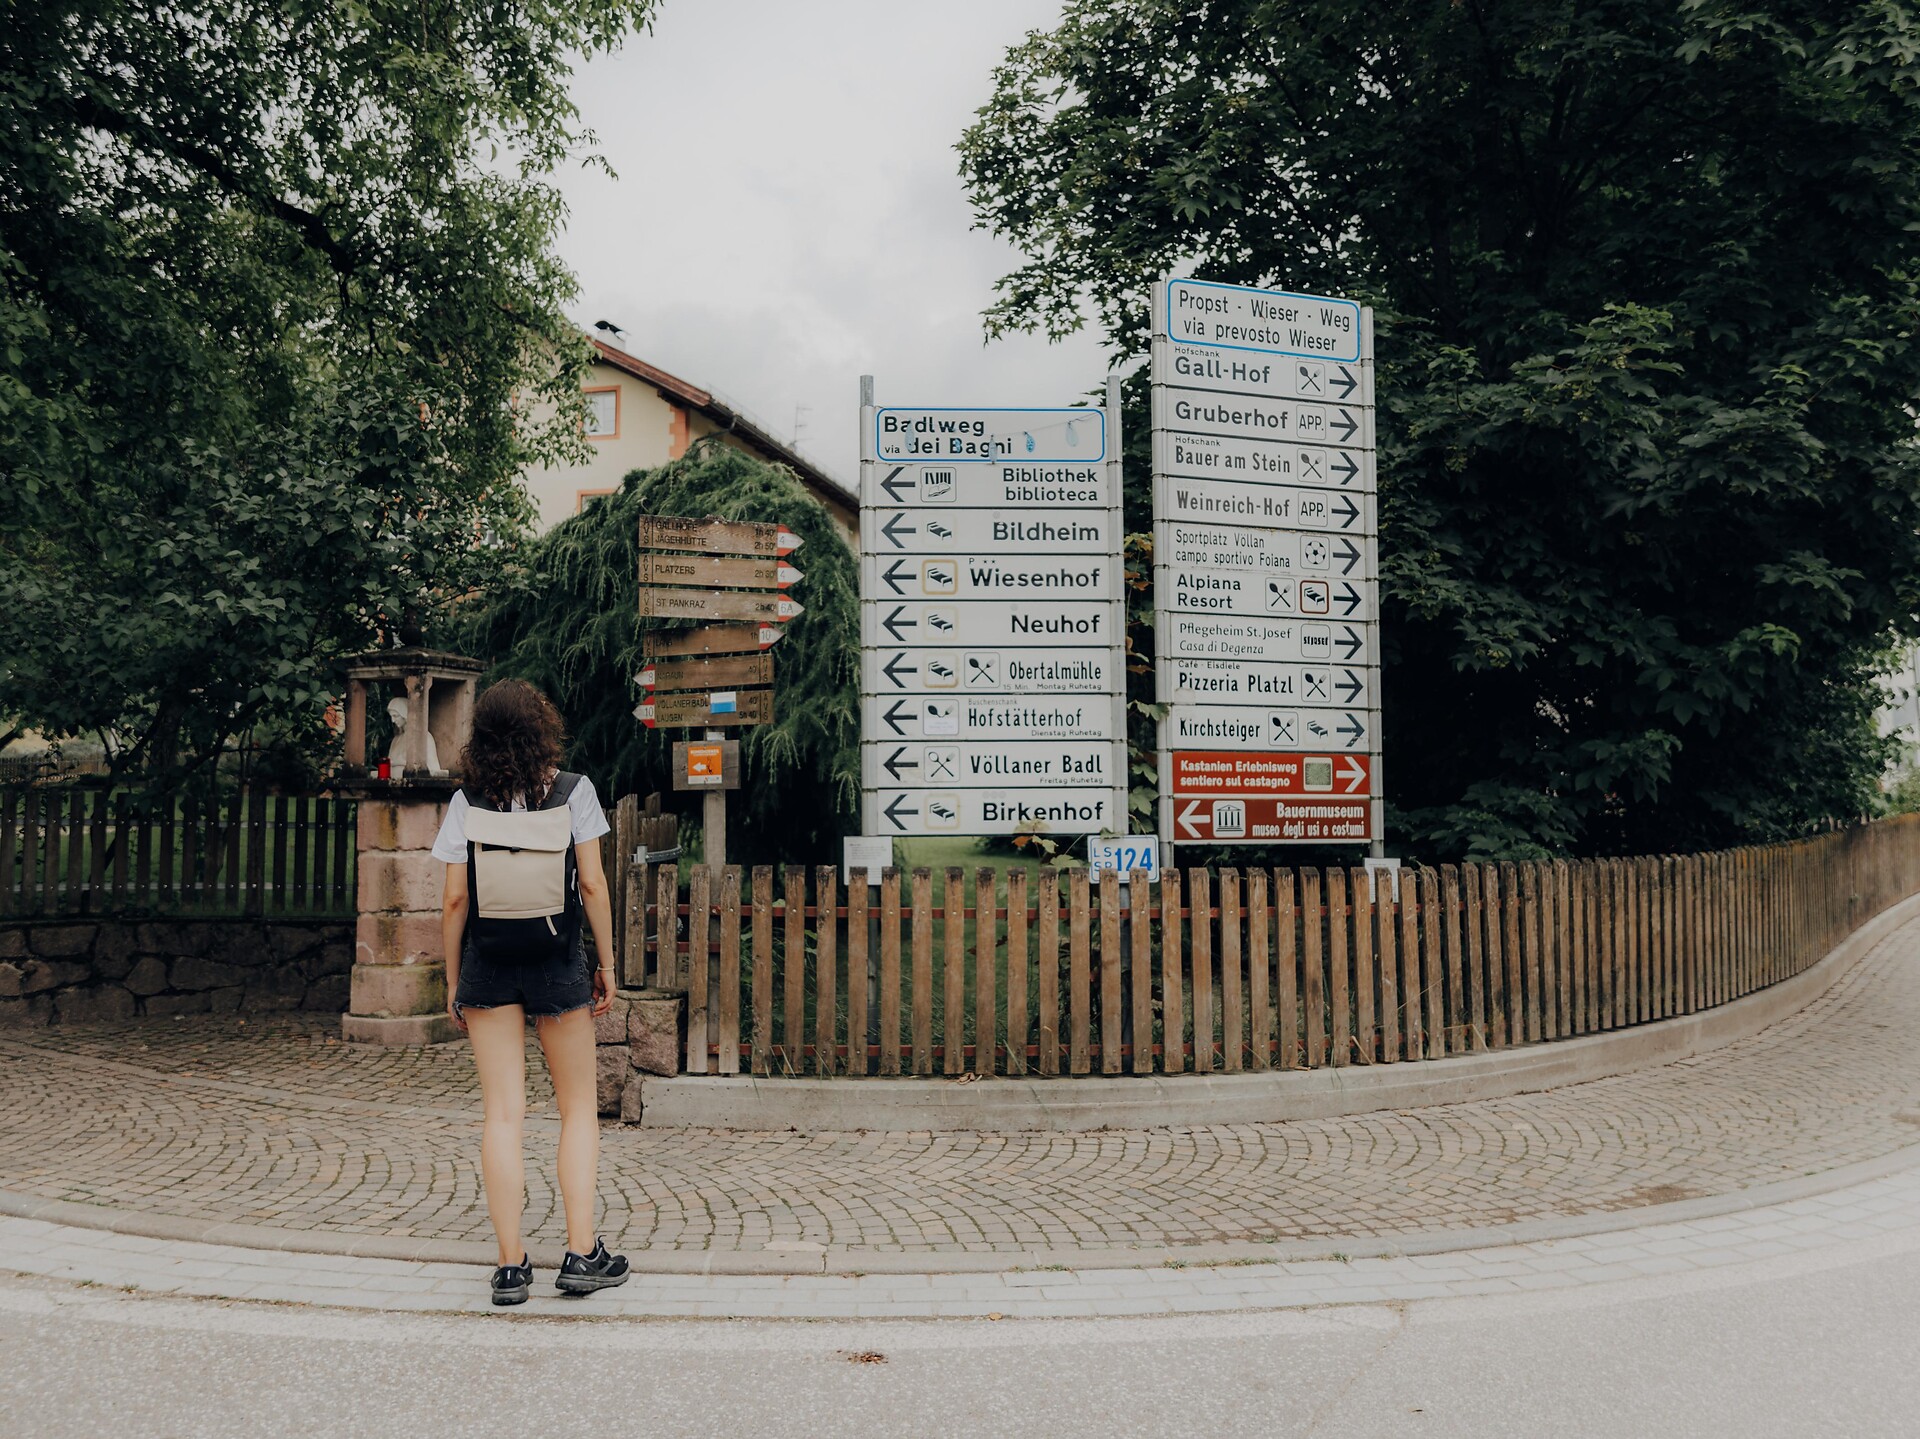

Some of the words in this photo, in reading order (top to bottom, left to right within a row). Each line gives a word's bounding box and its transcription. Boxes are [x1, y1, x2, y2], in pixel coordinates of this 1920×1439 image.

[1179, 289, 1229, 314] Propst
[1251, 299, 1299, 322] Wieser
[1320, 308, 1350, 332] Weg
[1184, 317, 1205, 336] via
[1216, 321, 1280, 344] prevosto
[1289, 329, 1336, 351] Wieser
[1174, 346, 1220, 358] Hofschank
[1175, 356, 1270, 384] Gall-Hof
[1175, 401, 1288, 429] Gruberhof
[1299, 414, 1324, 431] APP.
[884, 416, 984, 437] Badlweg
[885, 445, 900, 453] via
[1175, 436, 1221, 447] Hofschank
[1175, 446, 1219, 467] Bauer
[1225, 454, 1246, 469] am
[1253, 452, 1290, 473] Stein
[1002, 468, 1098, 482] Bibliothek
[1005, 487, 1098, 501] biblioteca
[1177, 490, 1290, 517] Weinreich-Hof
[1300, 502, 1325, 518] APP.
[993, 522, 1099, 541] Bildheim
[1176, 529, 1227, 546] Sportplatz
[1234, 533, 1264, 549] Völlan
[1176, 550, 1207, 565] campo
[1214, 551, 1253, 567] sportivo
[1259, 553, 1290, 568] Foiana
[655, 565, 695, 575] PLATZERS
[970, 568, 1100, 587] Wiesenhof
[1177, 573, 1241, 591] Alpiana
[669, 599, 705, 609] PANKRAZ
[780, 603, 793, 613] 6A
[1178, 592, 1233, 609] Resort
[1011, 614, 1100, 633] Neuhof
[1180, 622, 1243, 637] Pflegeheim
[1263, 627, 1292, 640] Josef
[761, 630, 771, 640] 10
[1180, 640, 1204, 652] Casa
[1207, 641, 1217, 652] di
[1221, 642, 1263, 656] Degenza
[1009, 661, 1101, 680] Obertalmühle
[1207, 661, 1240, 670] Eisdiele
[1037, 683, 1066, 691] Montag
[1069, 683, 1102, 691] Ruhetag
[1179, 672, 1238, 692] Pizzeria
[1248, 674, 1293, 694] Platzl
[644, 707, 654, 717] 10
[968, 708, 1082, 727] Hofstätterhof
[1031, 729, 1066, 737] Dienstag
[1069, 729, 1102, 737] Ruhetag
[1180, 717, 1260, 742] Kirchsteiger
[970, 755, 1051, 774] Völlaner
[1062, 754, 1103, 774] Badl
[1180, 760, 1232, 772] Kastanien
[1235, 760, 1297, 775] Erlebnisweg
[1071, 776, 1103, 784] Ruhetag
[1180, 776, 1222, 786] sentiero
[1225, 776, 1241, 787] sul
[1243, 776, 1290, 789] castagno
[983, 802, 1104, 821] Birkenhof
[1276, 802, 1364, 819] Bauernmuseum
[1252, 824, 1280, 837] museo
[1282, 822, 1304, 839] degli
[1307, 822, 1320, 837] usi
[1322, 825, 1329, 836] e
[1331, 821, 1364, 837] costumi
[1114, 847, 1153, 872] 124
